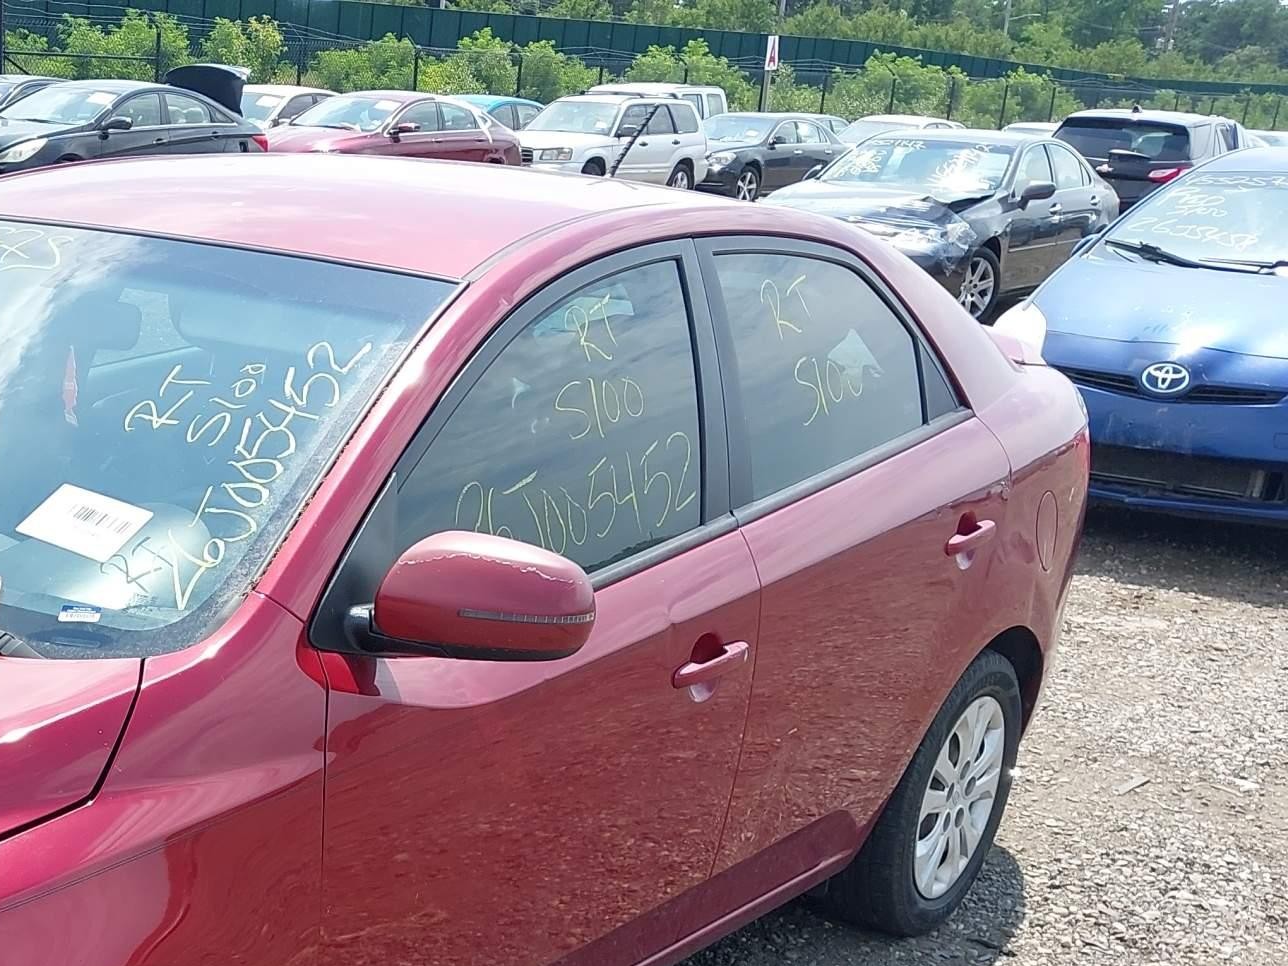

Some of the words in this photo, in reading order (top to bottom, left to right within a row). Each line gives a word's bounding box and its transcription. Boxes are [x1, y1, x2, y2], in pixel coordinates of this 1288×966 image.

[767, 36, 777, 68] A
[564, 293, 618, 362] RT
[761, 275, 813, 341] RT
[124, 365, 211, 432] RT
[186, 364, 266, 446] S100
[555, 376, 644, 439] S100
[167, 341, 372, 610] 26J005452
